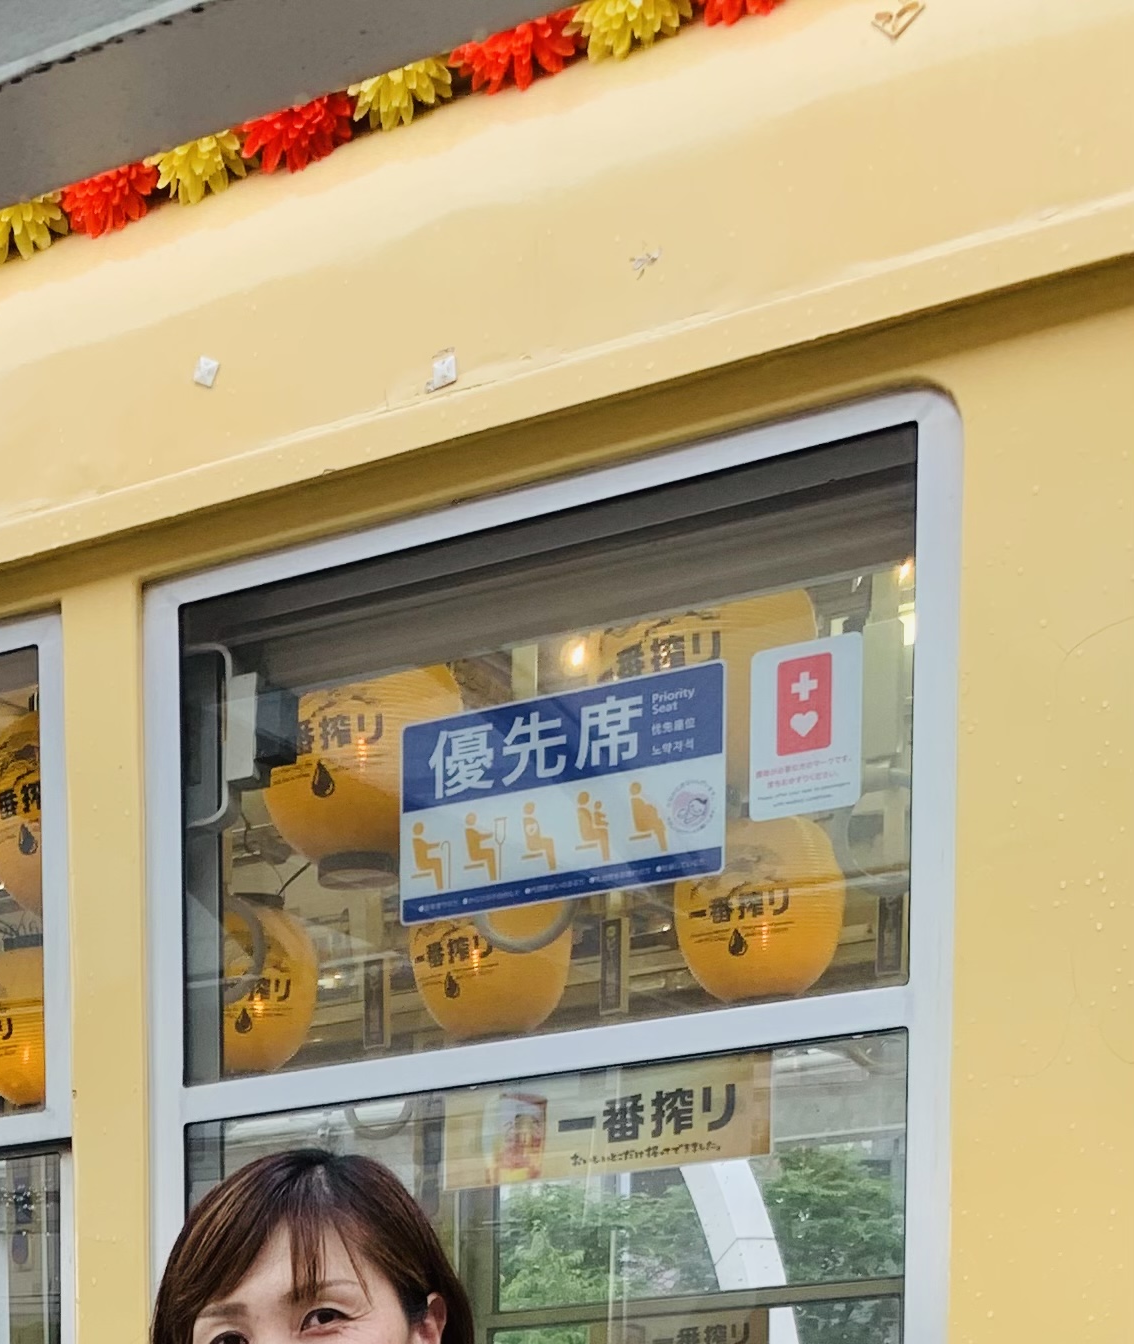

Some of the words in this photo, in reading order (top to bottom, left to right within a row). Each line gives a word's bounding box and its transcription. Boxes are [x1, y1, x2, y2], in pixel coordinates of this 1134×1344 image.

[651, 687, 695, 703] Priority
[651, 700, 678, 715] Seat
[428, 694, 644, 800] 優先席
[689, 887, 790, 924] 一番搾り
[558, 1083, 736, 1143] 一番搾り
